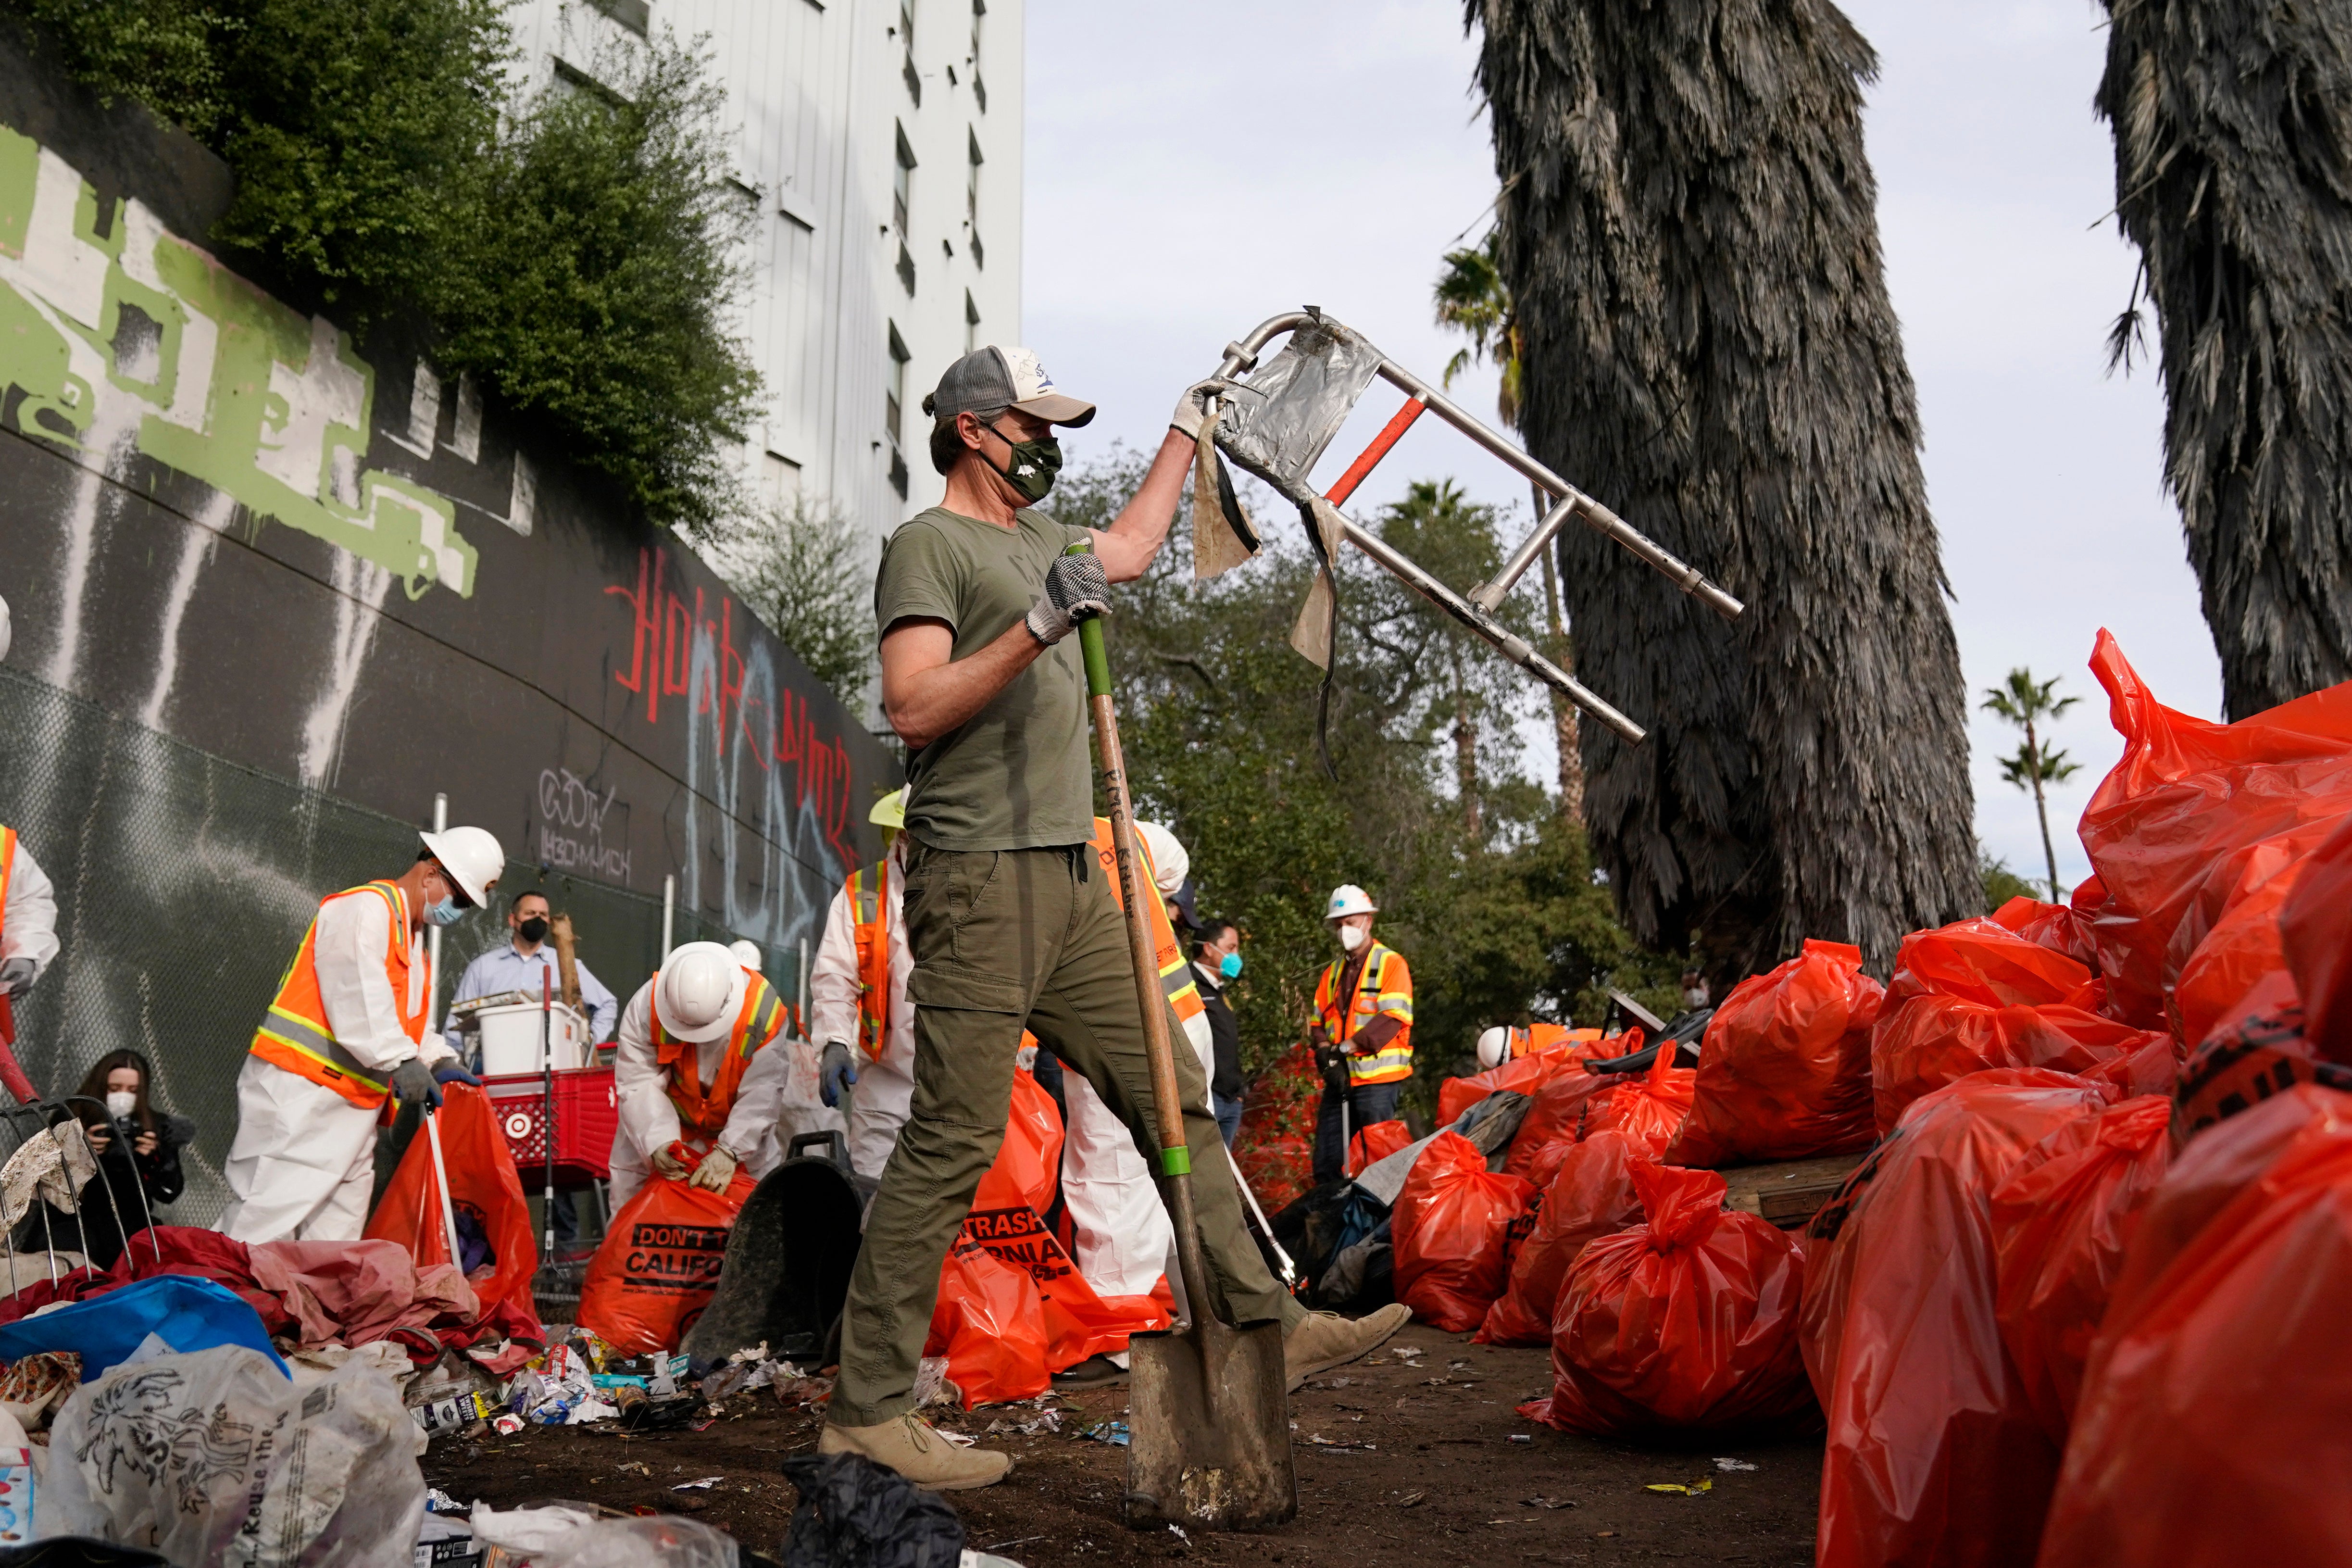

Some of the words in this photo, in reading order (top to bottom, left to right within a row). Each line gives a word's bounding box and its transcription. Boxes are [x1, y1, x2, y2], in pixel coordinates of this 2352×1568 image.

[638, 1227, 708, 1247] DON'T
[626, 1252, 724, 1277] CALIFO
[459, 1398, 470, 1421] SWEETS
[464, 1394, 475, 1420] SWISHER
[242, 1468, 267, 1535] Reuse
[255, 1429, 273, 1462] the
